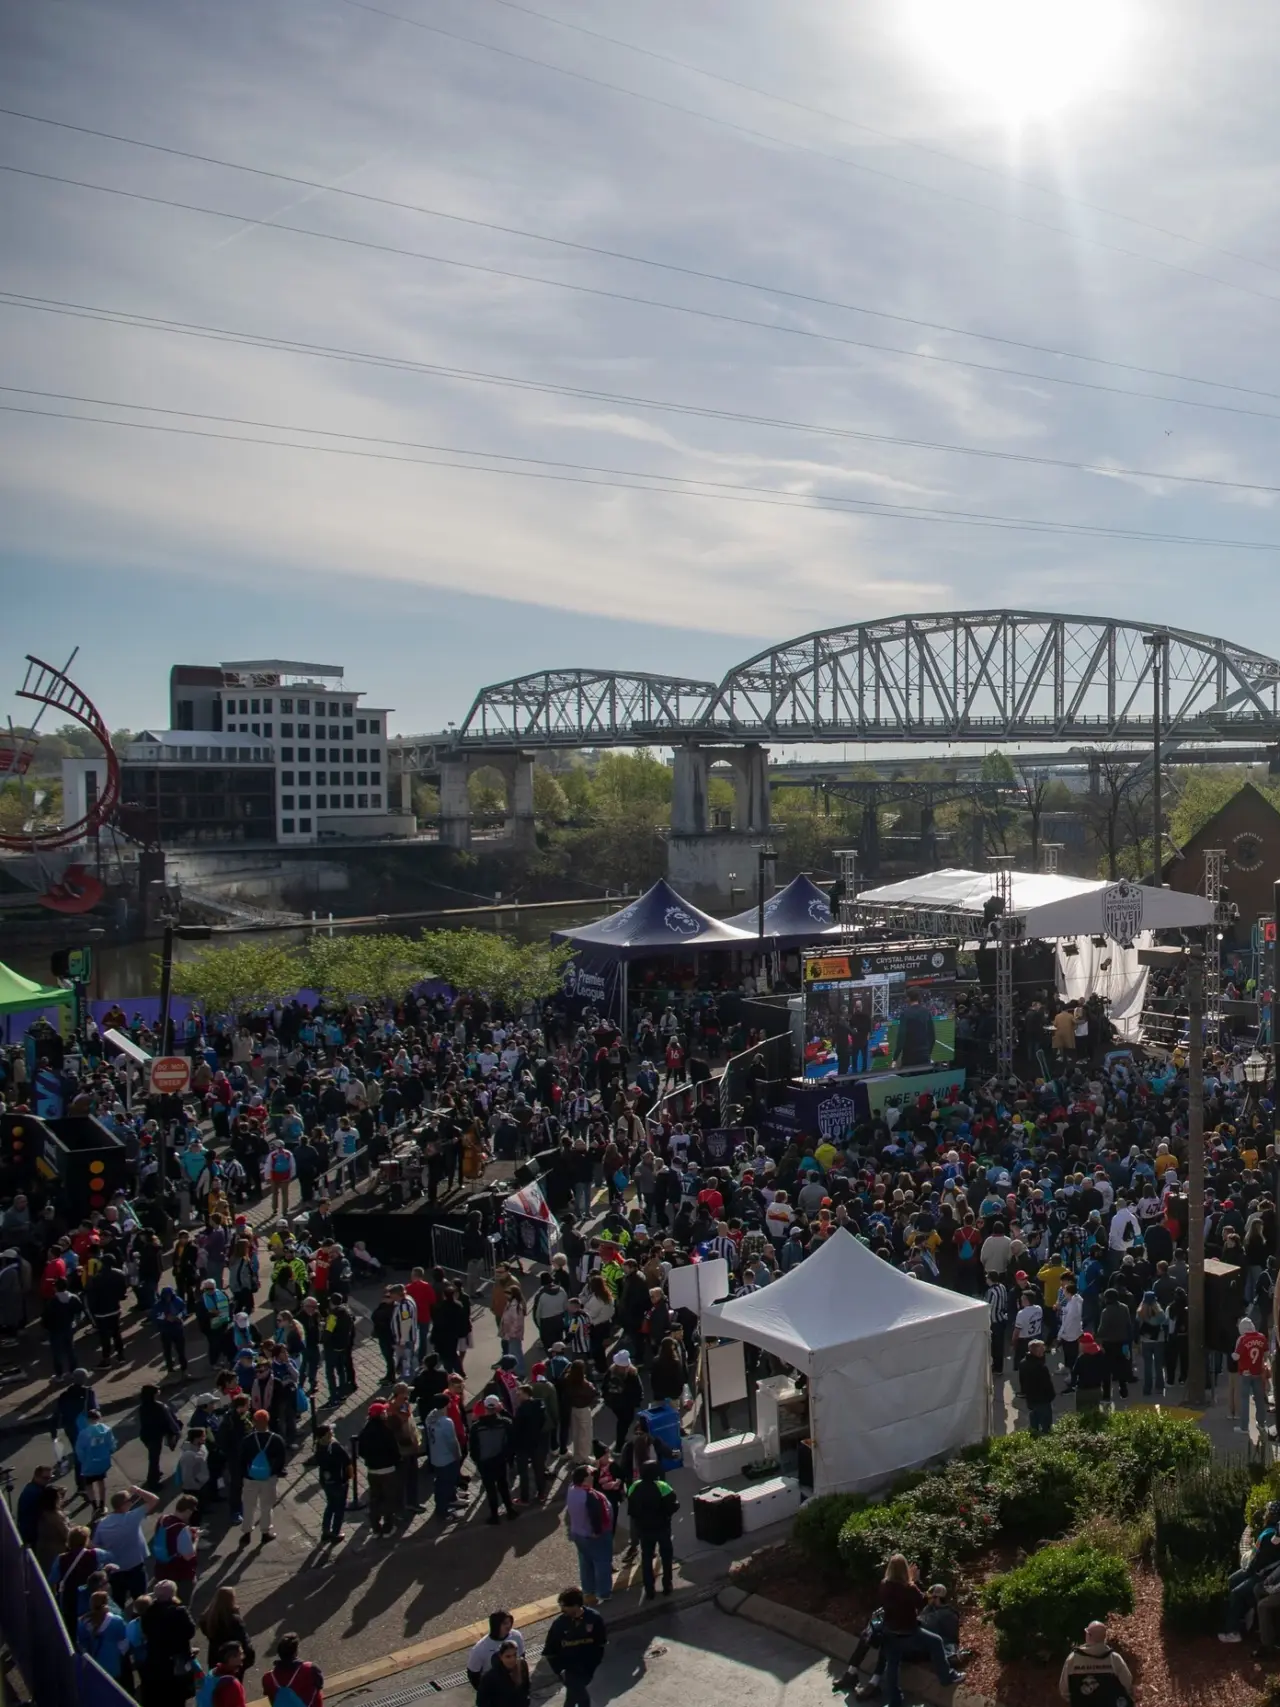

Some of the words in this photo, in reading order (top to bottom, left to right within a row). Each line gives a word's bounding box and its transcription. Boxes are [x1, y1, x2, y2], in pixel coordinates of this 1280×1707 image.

[1107, 904, 1141, 912] MORNINGS
[1114, 911, 1134, 922] LIVE
[876, 955, 903, 965] CRYSTAL
[904, 954, 928, 963] PALACE
[890, 963, 905, 971] MAN
[579, 968, 605, 986] Premier
[577, 981, 605, 1002] League
[671, 1050, 680, 1060] 16
[158, 1079, 182, 1087] ENTER
[884, 1091, 910, 1107] RISE
[820, 1111, 853, 1119] MORNINGS
[827, 1117, 846, 1126] LIVE
[681, 1181, 692, 1194] 17
[1145, 1203, 1160, 1216] 47
[1250, 1347, 1260, 1365] 9
